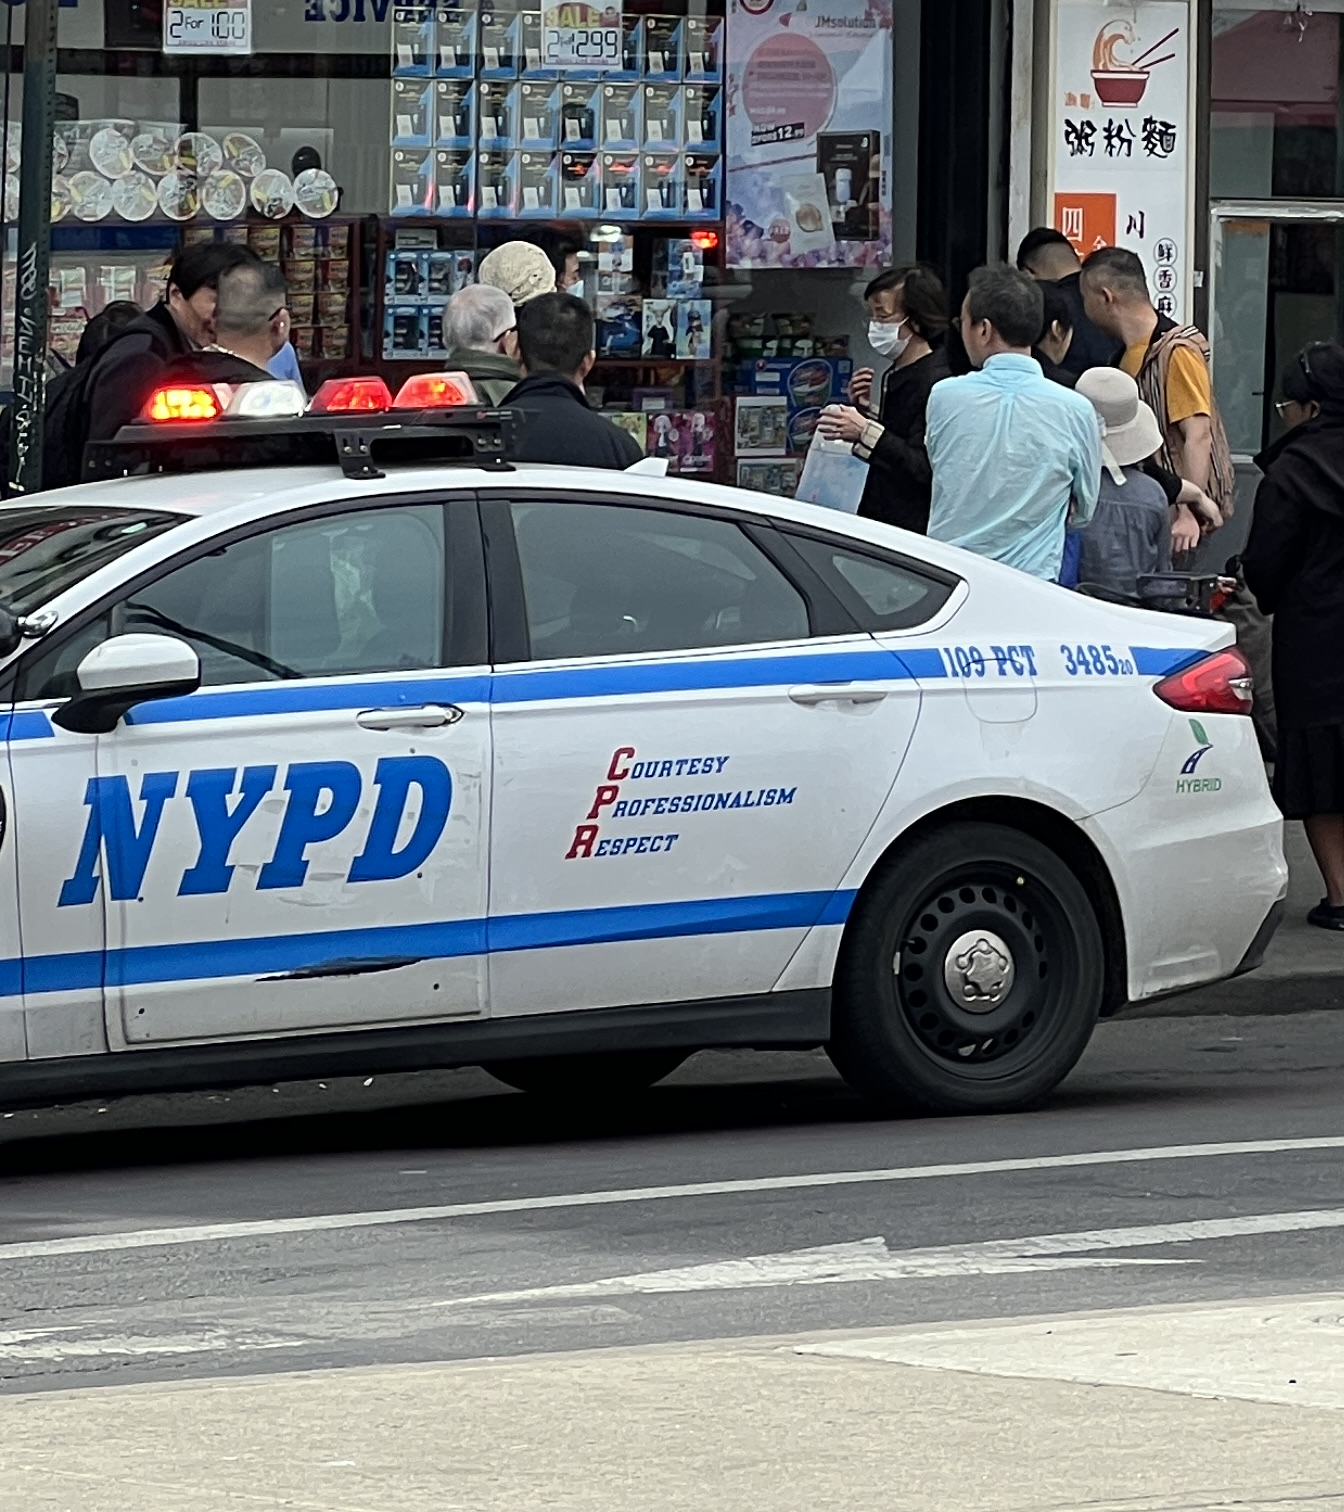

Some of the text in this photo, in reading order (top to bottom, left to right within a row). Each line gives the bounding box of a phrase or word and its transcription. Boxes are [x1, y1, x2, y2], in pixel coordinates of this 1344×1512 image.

[169, 11, 184, 39] 2
[545, 5, 600, 27] SALE
[945, 646, 986, 679] 109
[991, 645, 1037, 677] PCT
[1061, 644, 1119, 675] 3485
[606, 747, 730, 782] COURTESY
[586, 784, 798, 821] PROFESSIONALISM
[1174, 777, 1223, 794] HYBRID
[56, 754, 455, 909] NYPD
[564, 825, 680, 861] RESPECT
